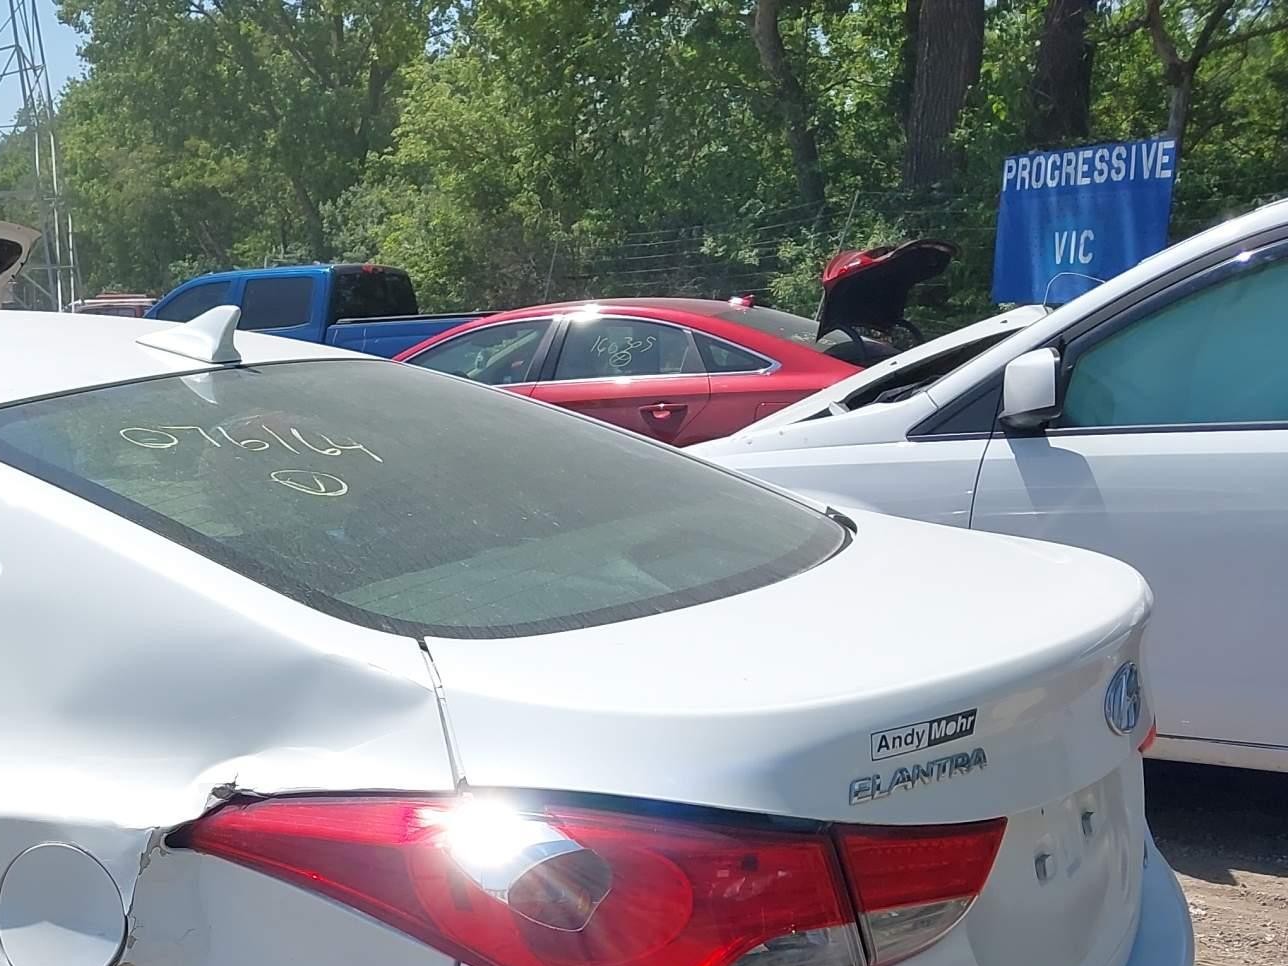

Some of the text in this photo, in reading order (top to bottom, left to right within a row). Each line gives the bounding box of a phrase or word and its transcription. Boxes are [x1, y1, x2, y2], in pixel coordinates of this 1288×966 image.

[1002, 140, 1175, 191] PROGRESSIVE
[1054, 229, 1094, 264] VIC
[876, 713, 975, 753] Andy Mohr
[848, 747, 988, 806] ELANTRA
